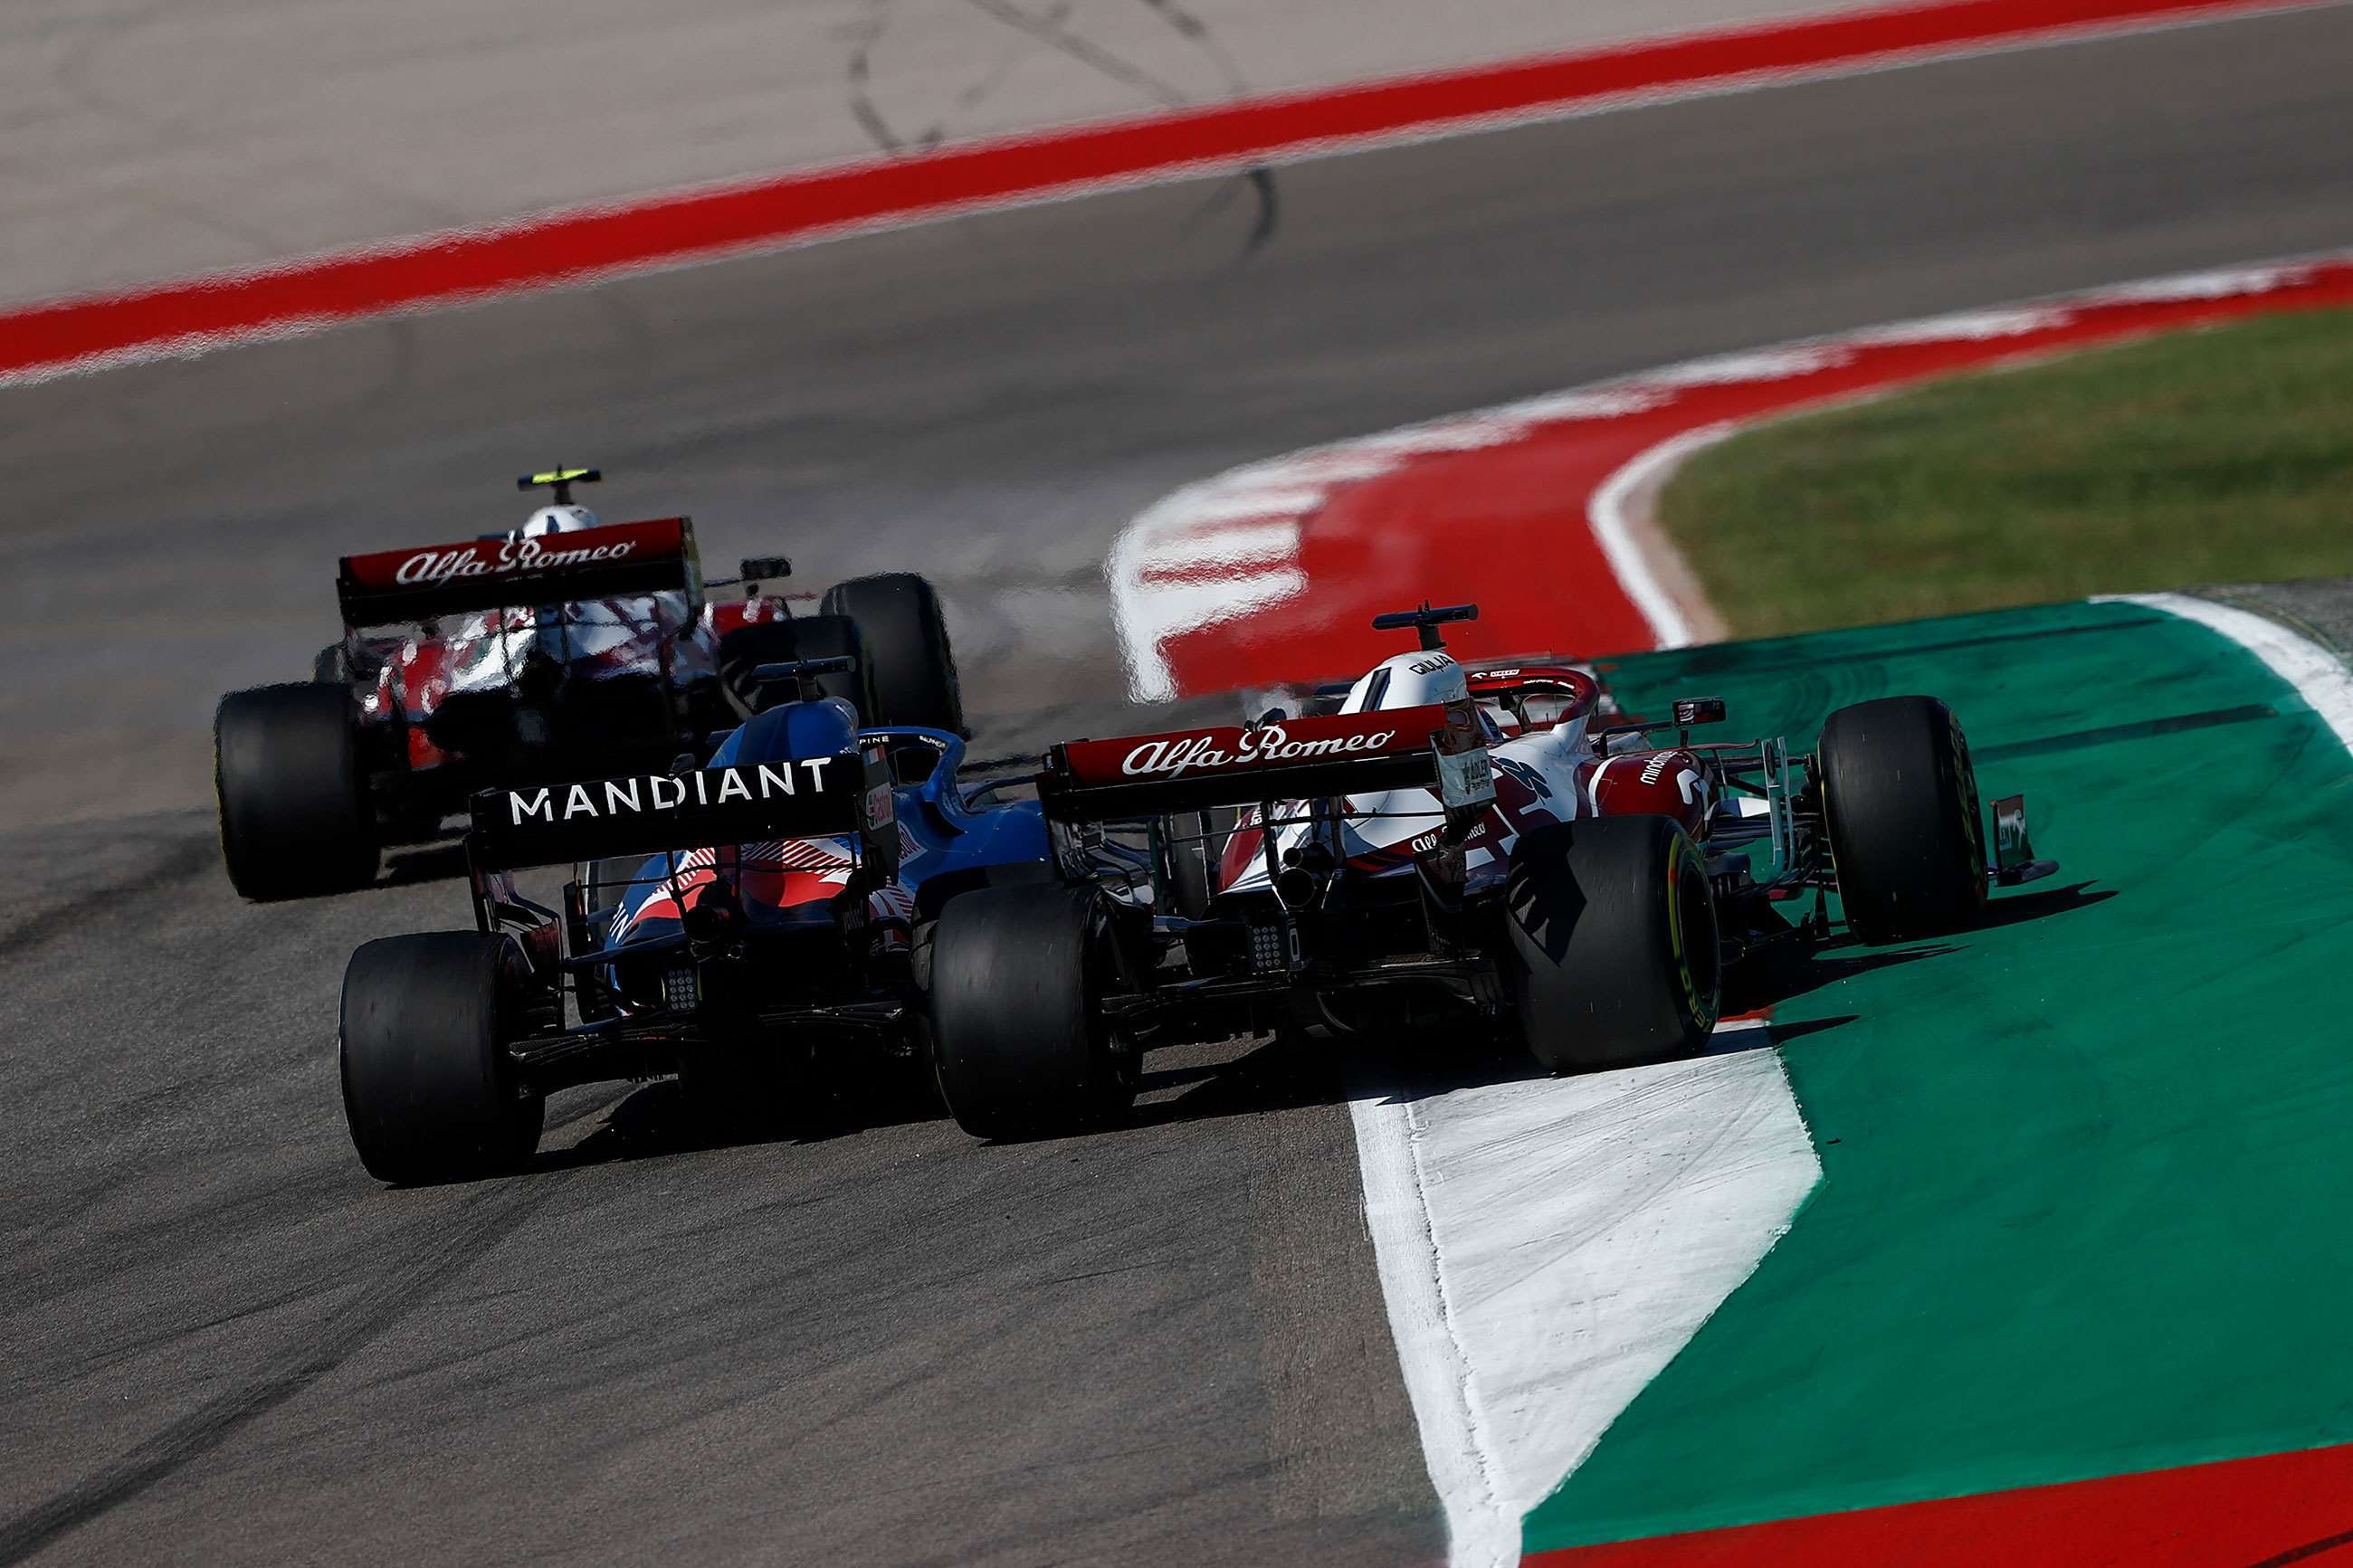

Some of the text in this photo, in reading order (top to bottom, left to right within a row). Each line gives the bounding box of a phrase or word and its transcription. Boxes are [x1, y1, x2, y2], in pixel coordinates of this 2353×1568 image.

[395, 535, 636, 586] Alfa Romeo
[1408, 653, 1455, 676] GIULIA
[1122, 724, 1396, 779] Alfa Romeo
[508, 756, 833, 826] MANDIANT
